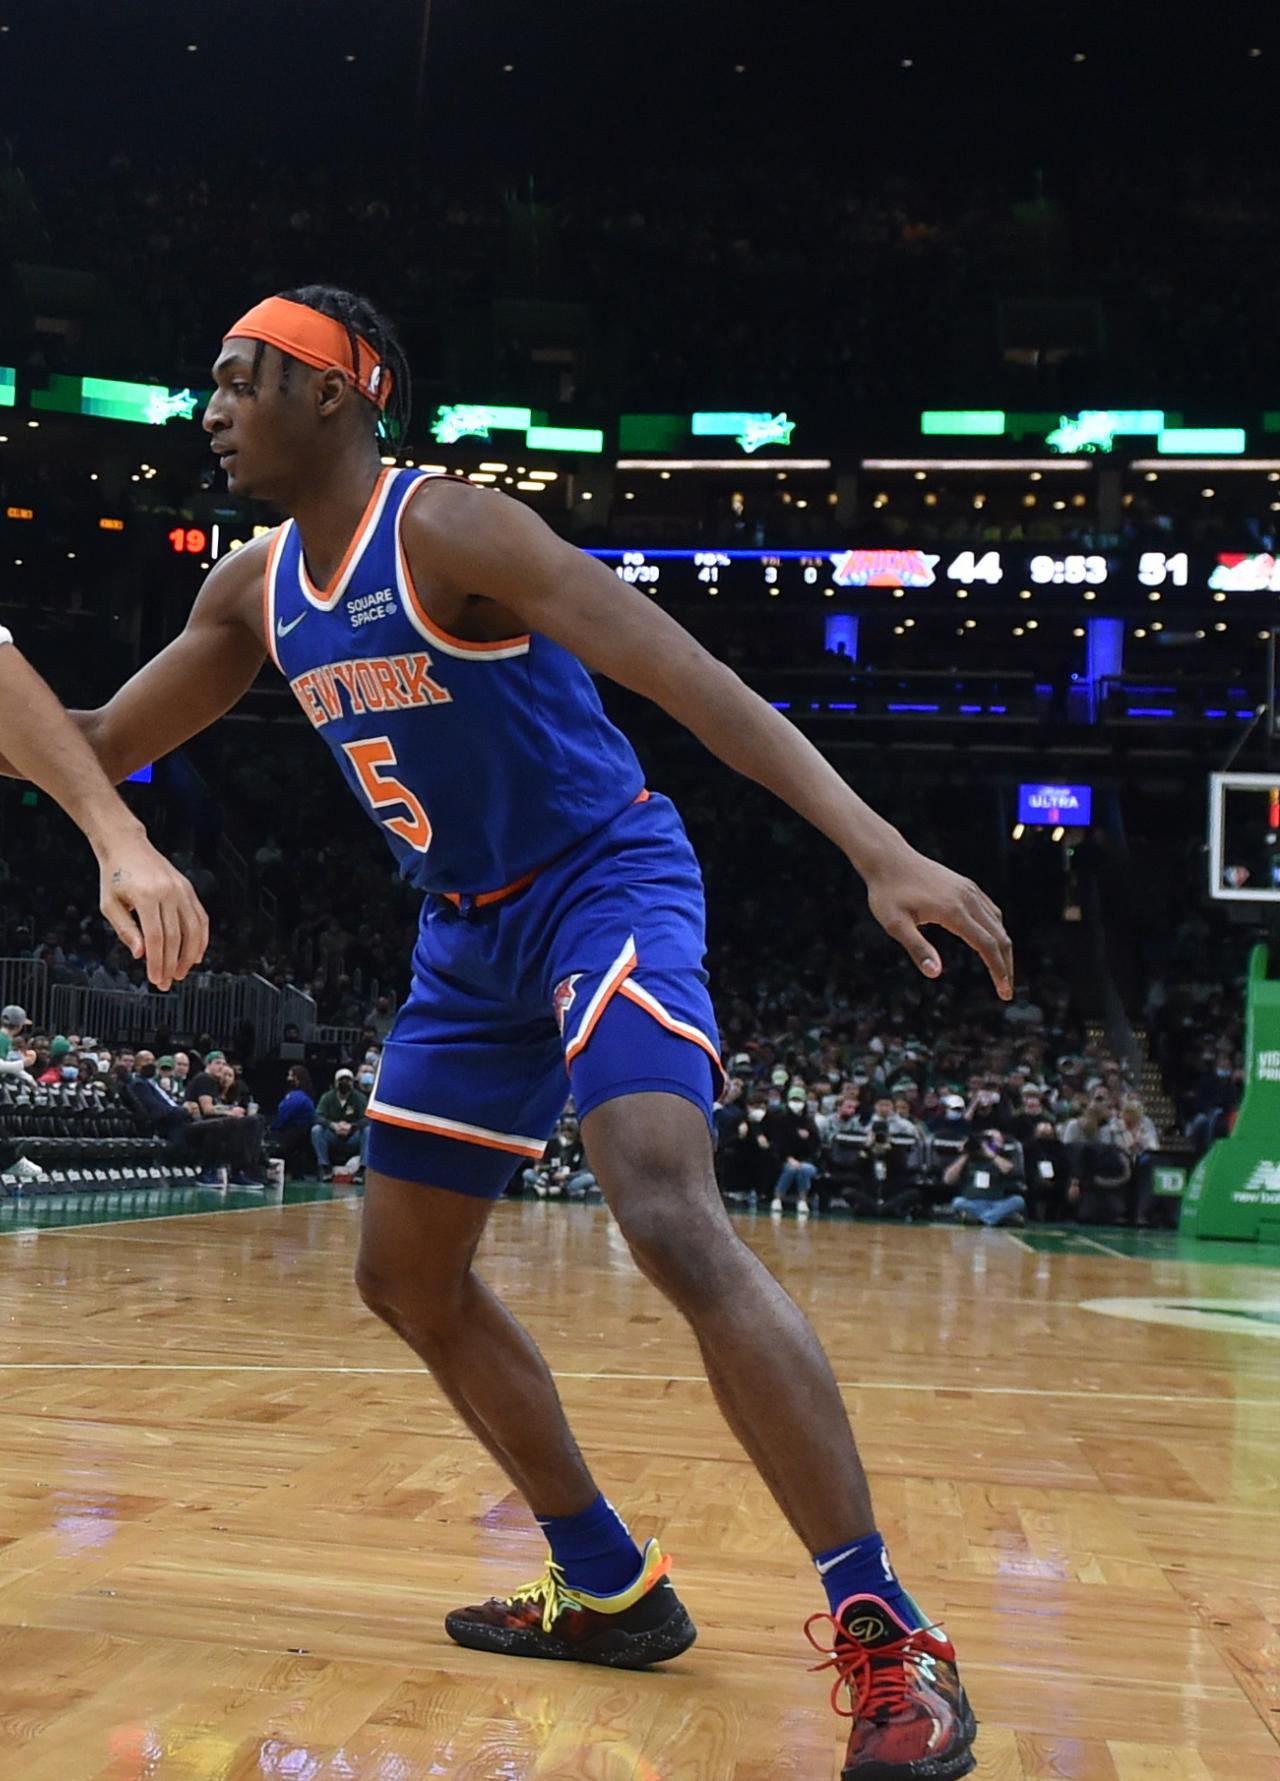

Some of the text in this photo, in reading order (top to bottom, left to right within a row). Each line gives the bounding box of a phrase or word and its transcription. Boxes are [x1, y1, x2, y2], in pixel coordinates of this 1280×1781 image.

[169, 527, 206, 553] 19
[698, 566, 719, 583] 41
[765, 566, 778, 584] 3
[804, 566, 818, 584] 0
[947, 551, 1004, 584] 44
[1030, 555, 1108, 584] 9:53
[1138, 552, 1188, 586] 51
[346, 588, 394, 614] SQUARE
[350, 605, 386, 628] SPACE
[289, 651, 454, 729] EW YORK
[341, 736, 433, 854] 5
[1028, 795, 1079, 809] ULTRA
[1154, 1169, 1185, 1192] TD
[1232, 1191, 1260, 1204] new
